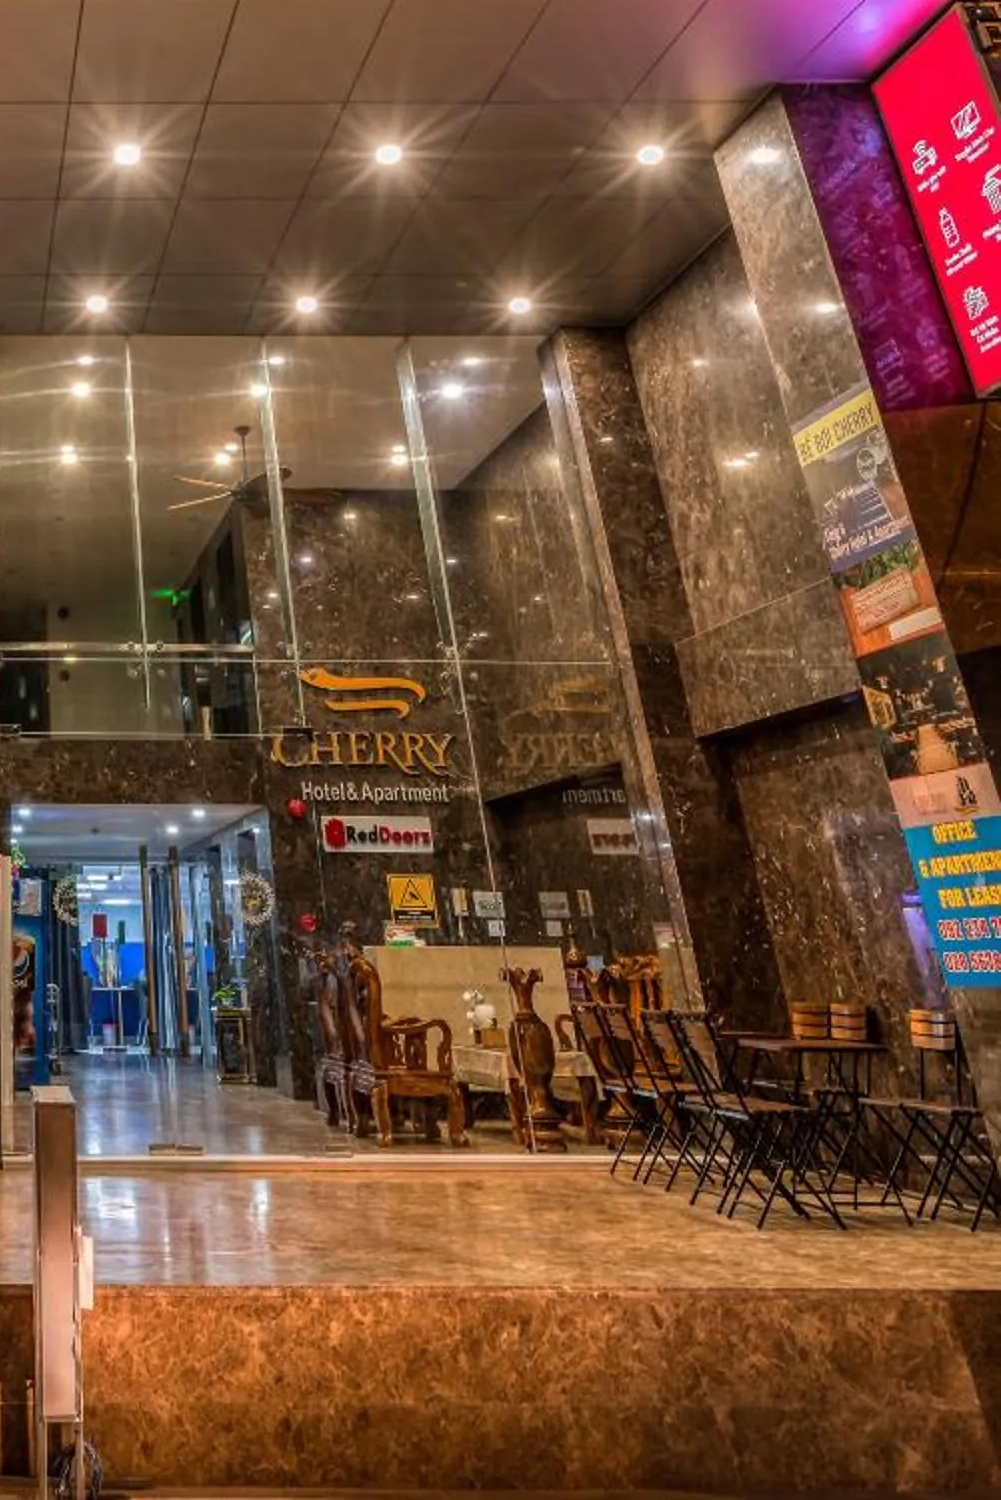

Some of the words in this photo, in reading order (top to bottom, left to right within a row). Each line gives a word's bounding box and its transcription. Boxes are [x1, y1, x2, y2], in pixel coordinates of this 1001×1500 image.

[270, 731, 456, 777] CHERRY
[346, 823, 432, 845] RedDoorz
[932, 820, 978, 844] OFFICE
[938, 887, 966, 909] FOR
